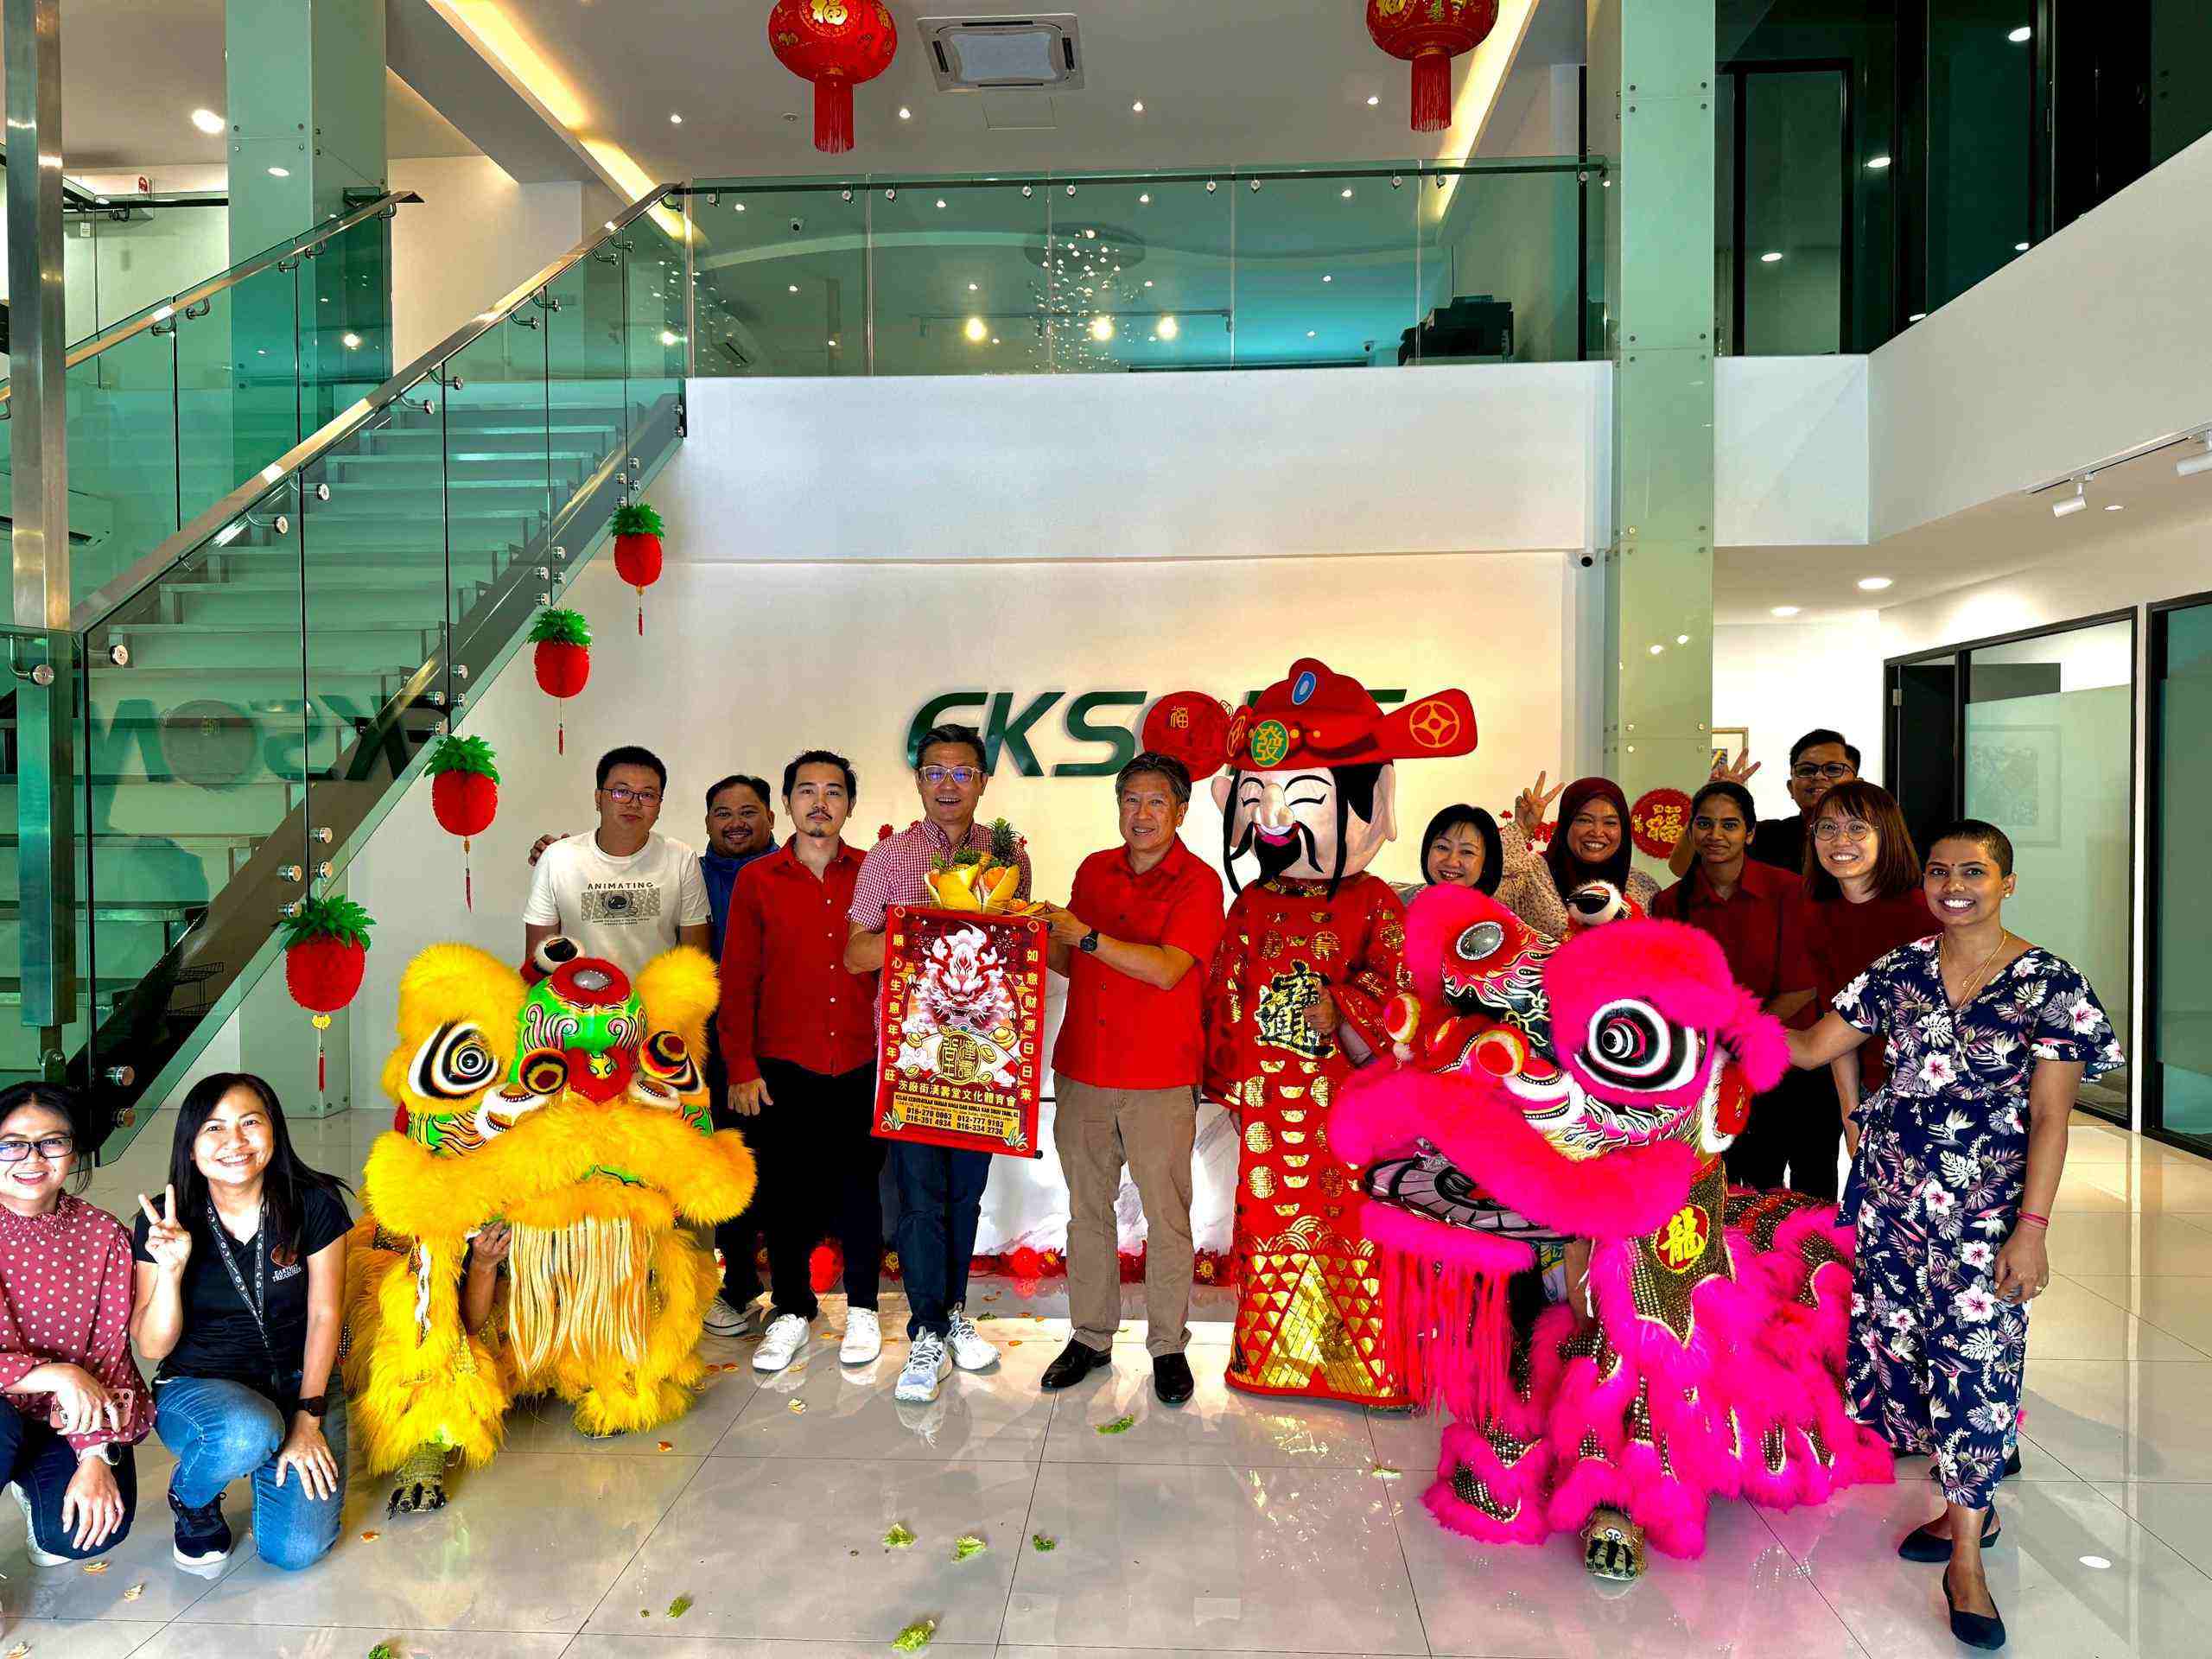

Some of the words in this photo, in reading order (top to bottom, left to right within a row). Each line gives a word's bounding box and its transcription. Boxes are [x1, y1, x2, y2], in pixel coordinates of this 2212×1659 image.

[1255, 726, 1283, 761] 發
[588, 881, 654, 890] ANIMATING
[957, 1115, 986, 1124] 012-777
[1658, 1206, 1707, 1267] 龍
